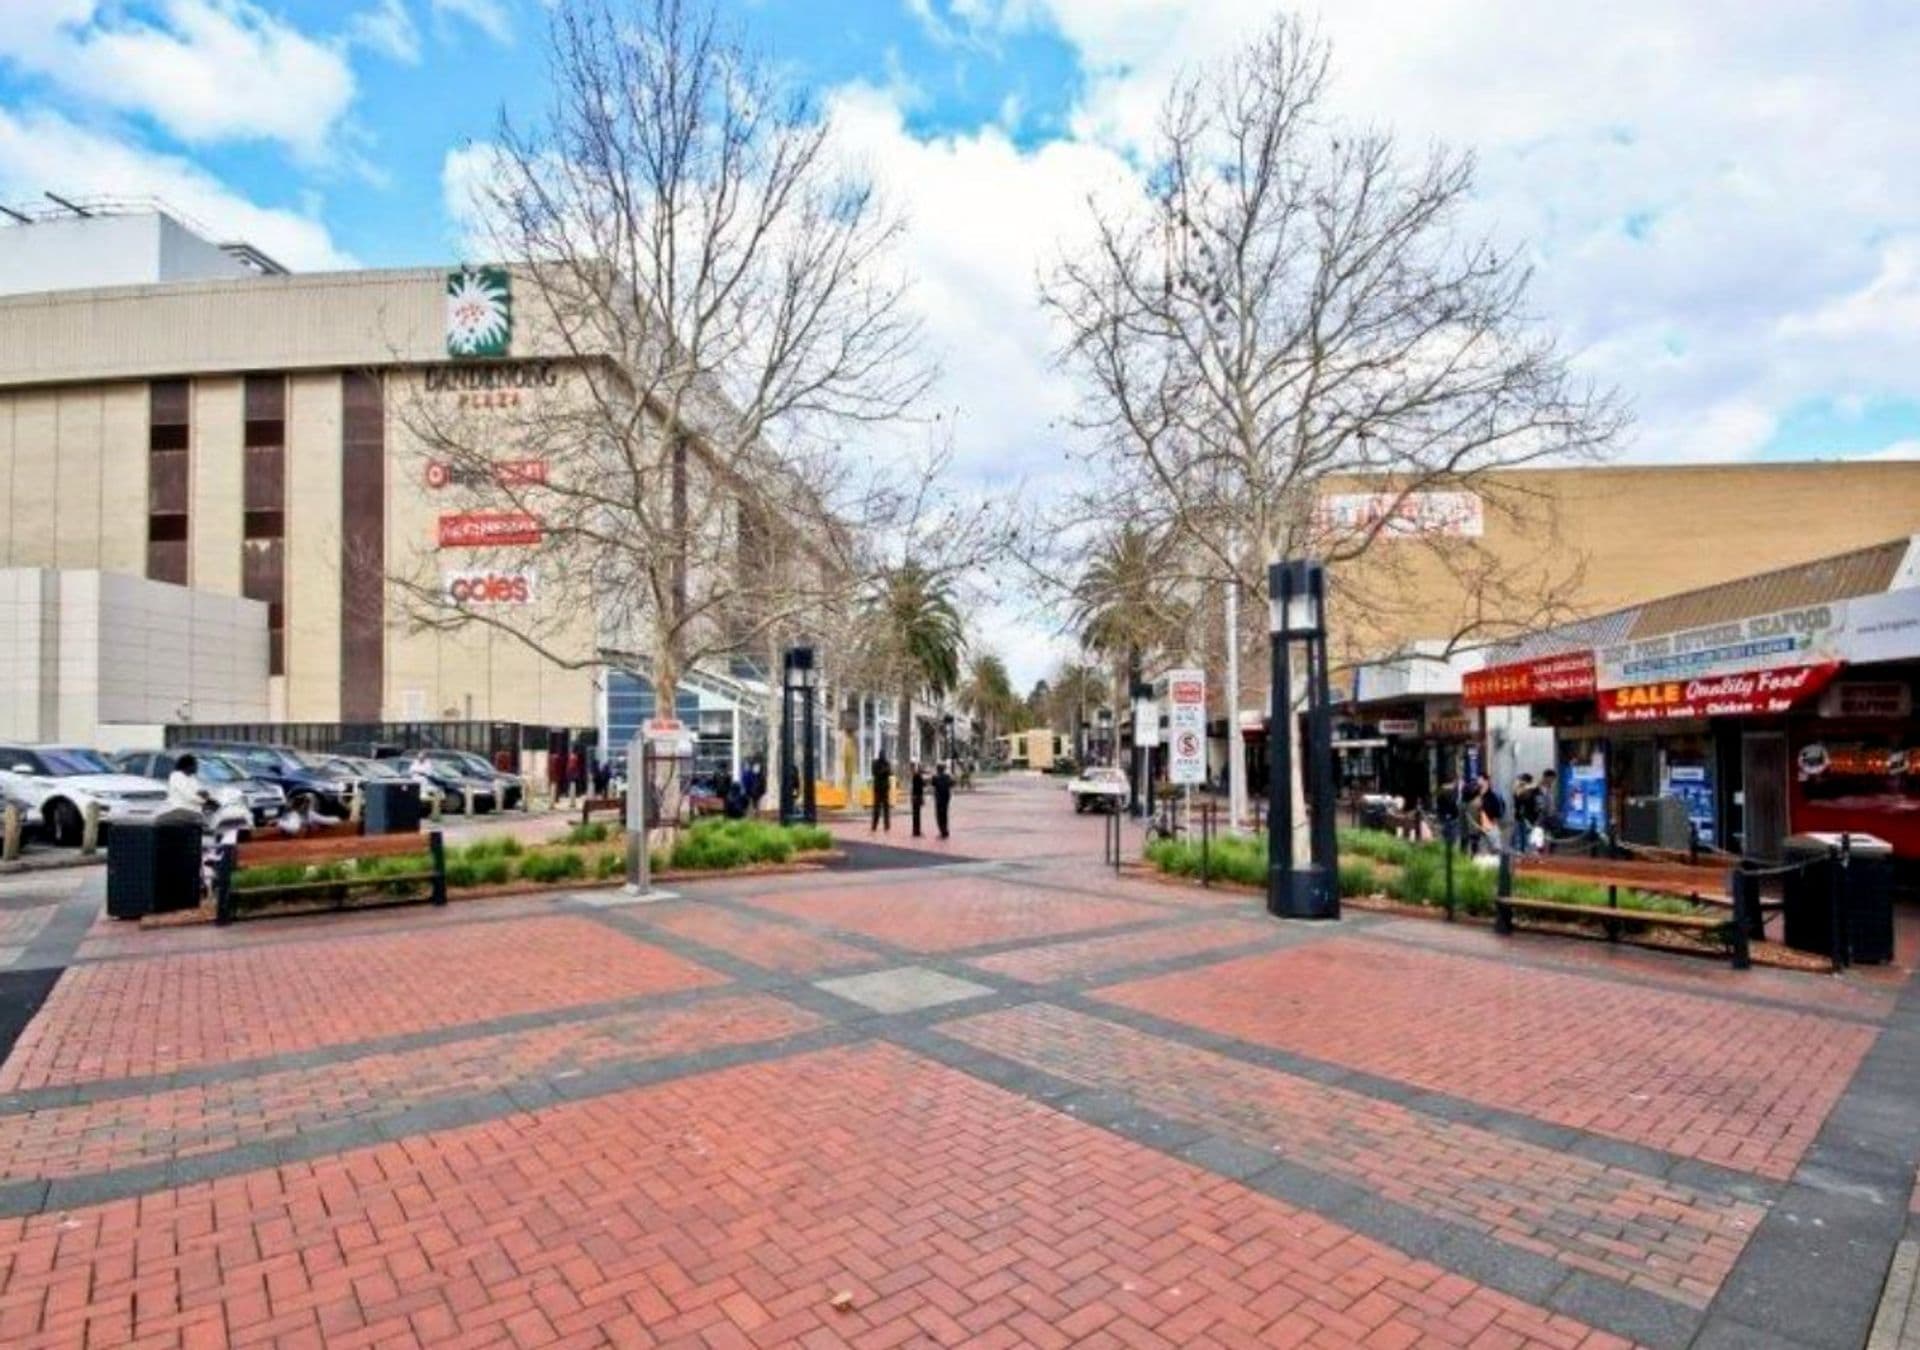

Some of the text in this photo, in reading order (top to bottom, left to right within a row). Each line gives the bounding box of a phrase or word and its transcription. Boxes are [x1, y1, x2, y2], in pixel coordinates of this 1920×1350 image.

[452, 573, 528, 602] coles
[1616, 669, 1811, 706] SALE Quality Food
